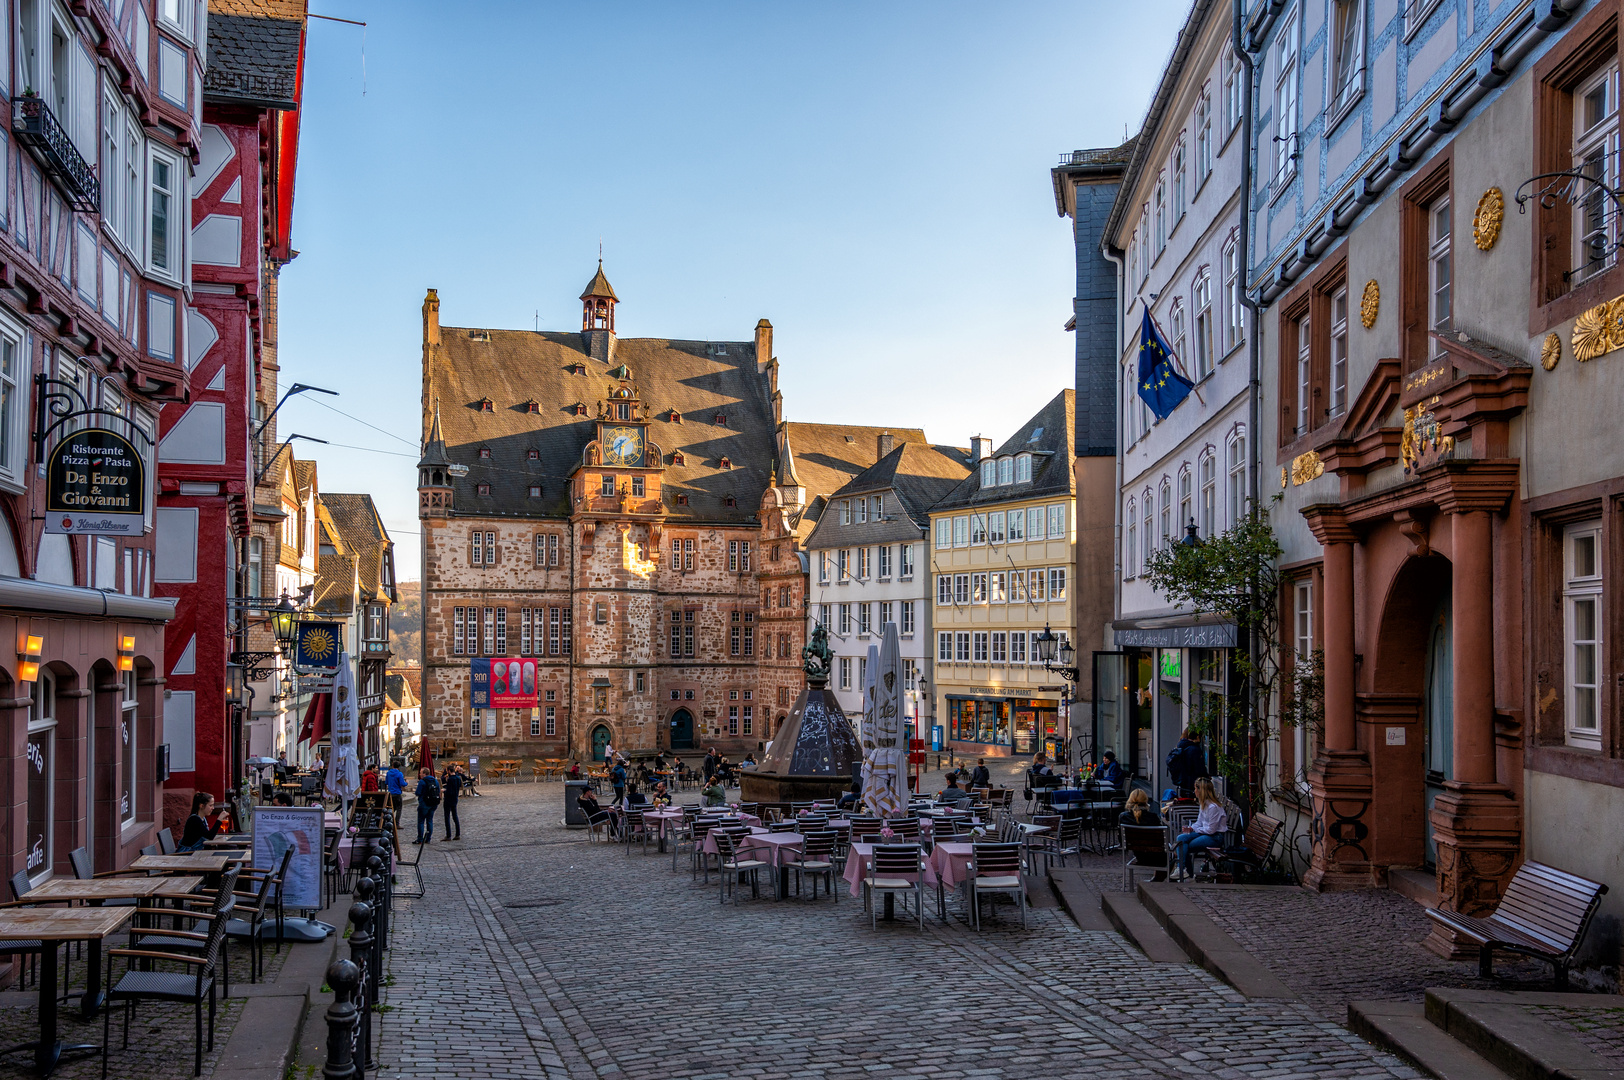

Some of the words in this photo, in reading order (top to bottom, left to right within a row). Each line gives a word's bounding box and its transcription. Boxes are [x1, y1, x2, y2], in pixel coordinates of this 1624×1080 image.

[72, 444, 124, 456] Ristorante
[62, 455, 89, 465] Pizza
[105, 457, 132, 467] Pasta
[65, 471, 88, 484] Da
[92, 472, 129, 486] Enzo
[90, 486, 102, 495] &
[61, 492, 130, 507] Giovanni
[969, 686, 1006, 695] BUCHHANDLUNG
